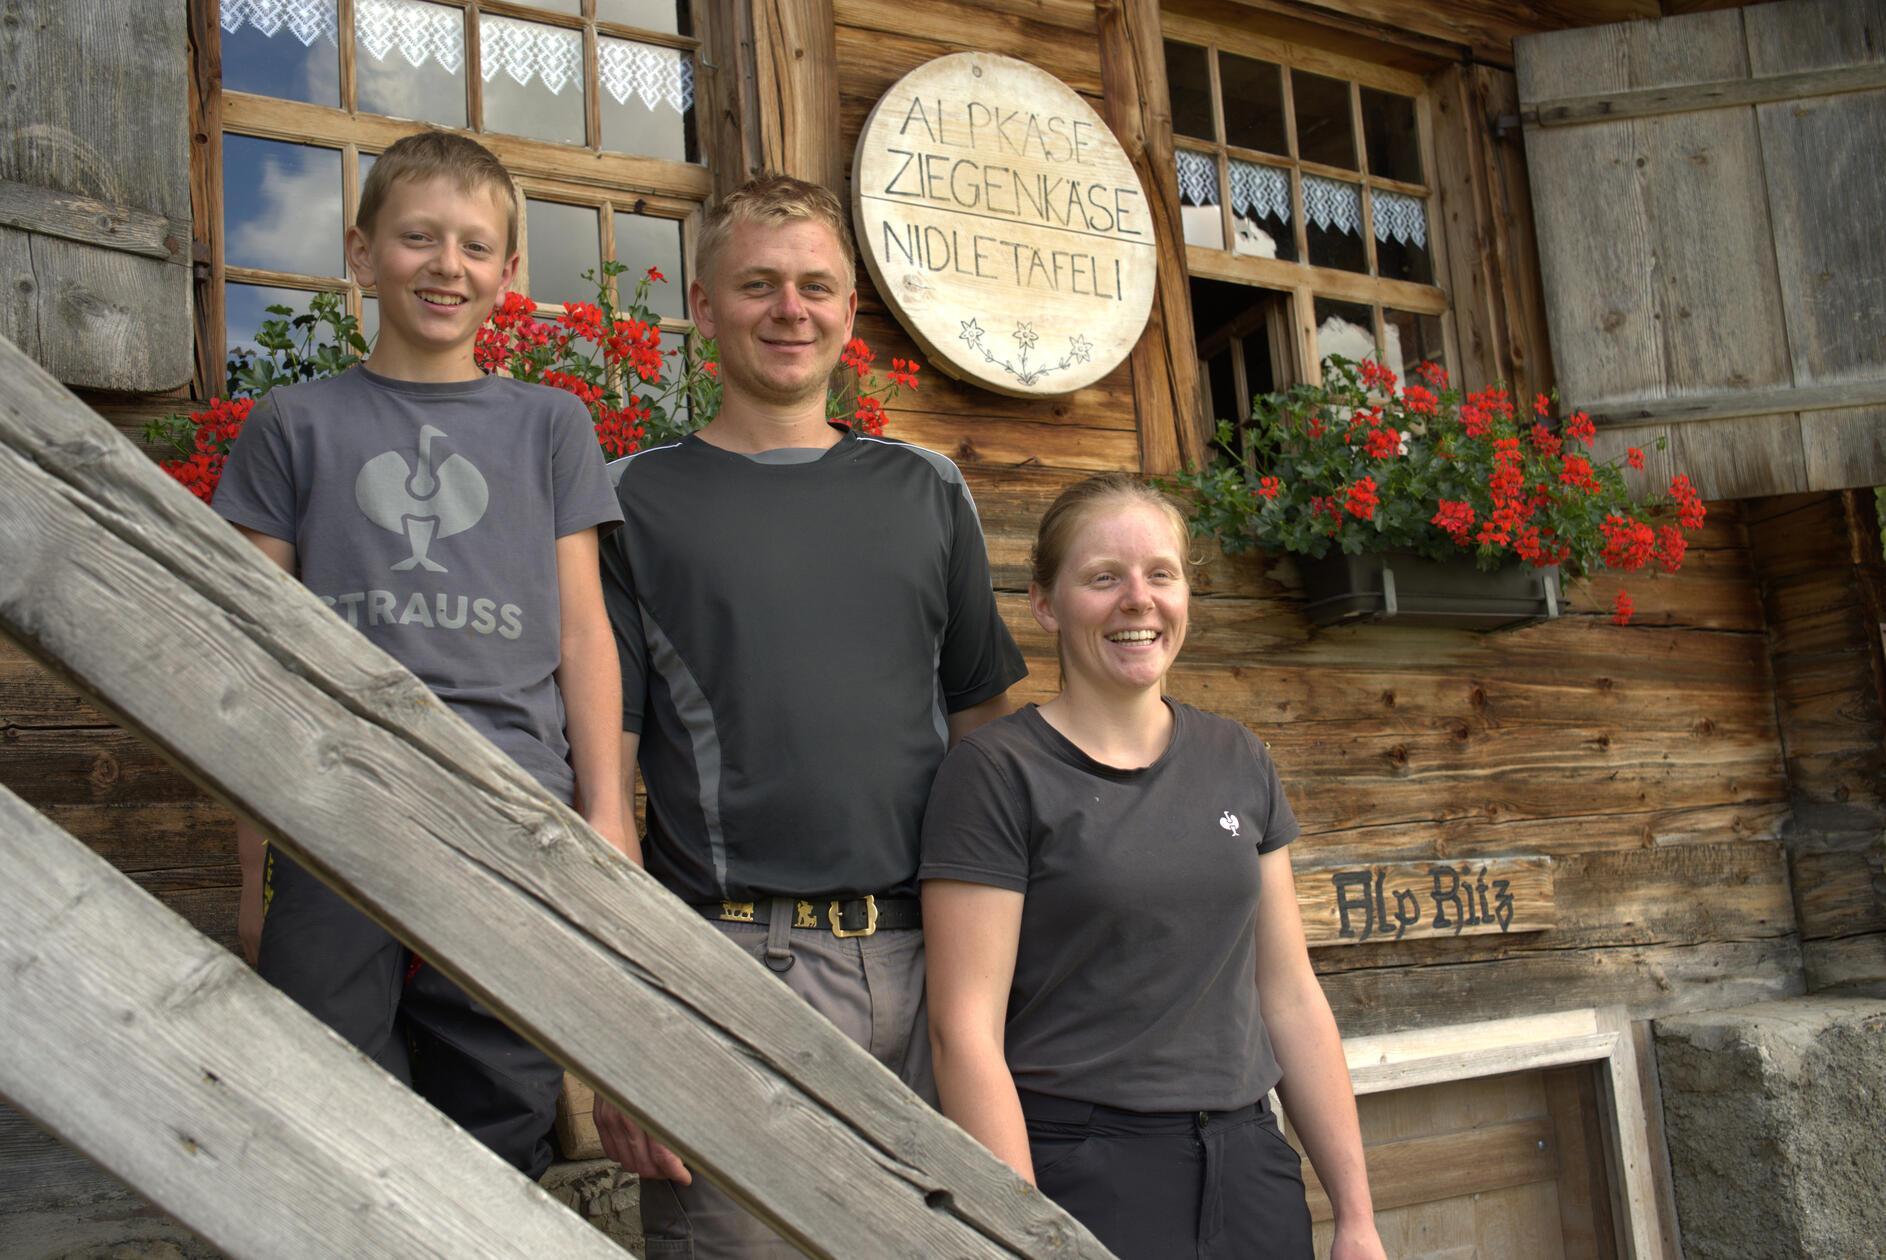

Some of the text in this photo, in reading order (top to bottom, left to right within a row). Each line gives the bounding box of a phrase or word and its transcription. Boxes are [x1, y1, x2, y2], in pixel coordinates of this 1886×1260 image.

[900, 97, 1095, 166] ALPKÄSE
[885, 149, 1141, 235] ZIEGENKÄSE
[319, 590, 522, 639] TRAUSS
[1332, 870, 1421, 941] Alp
